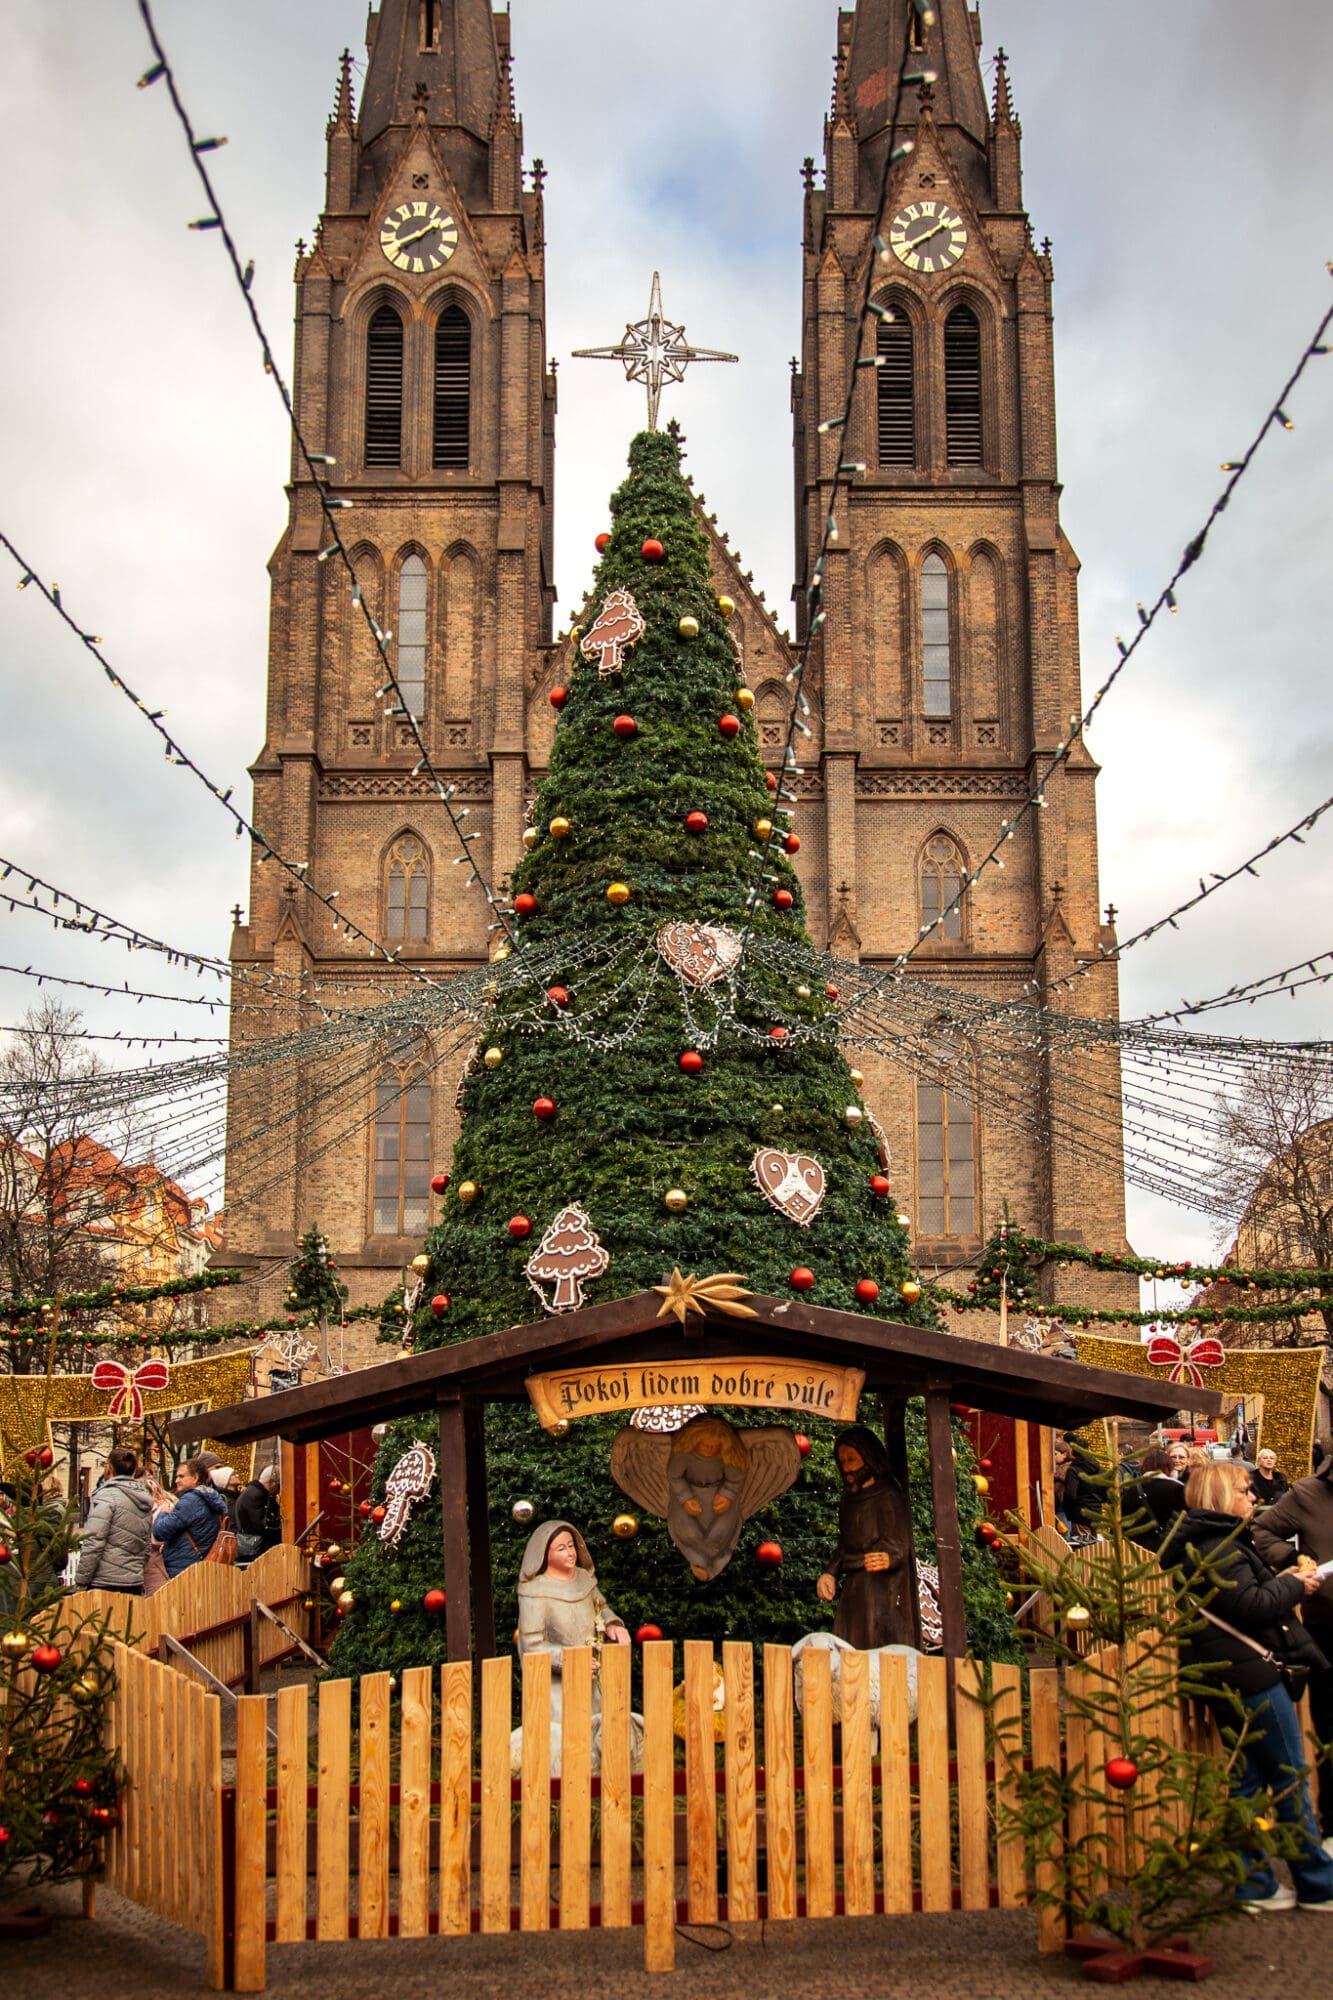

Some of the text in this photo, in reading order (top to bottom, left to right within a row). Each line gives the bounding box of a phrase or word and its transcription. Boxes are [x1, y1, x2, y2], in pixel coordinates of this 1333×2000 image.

[559, 1368, 835, 1412] Pokoj lidem dobré vůle
